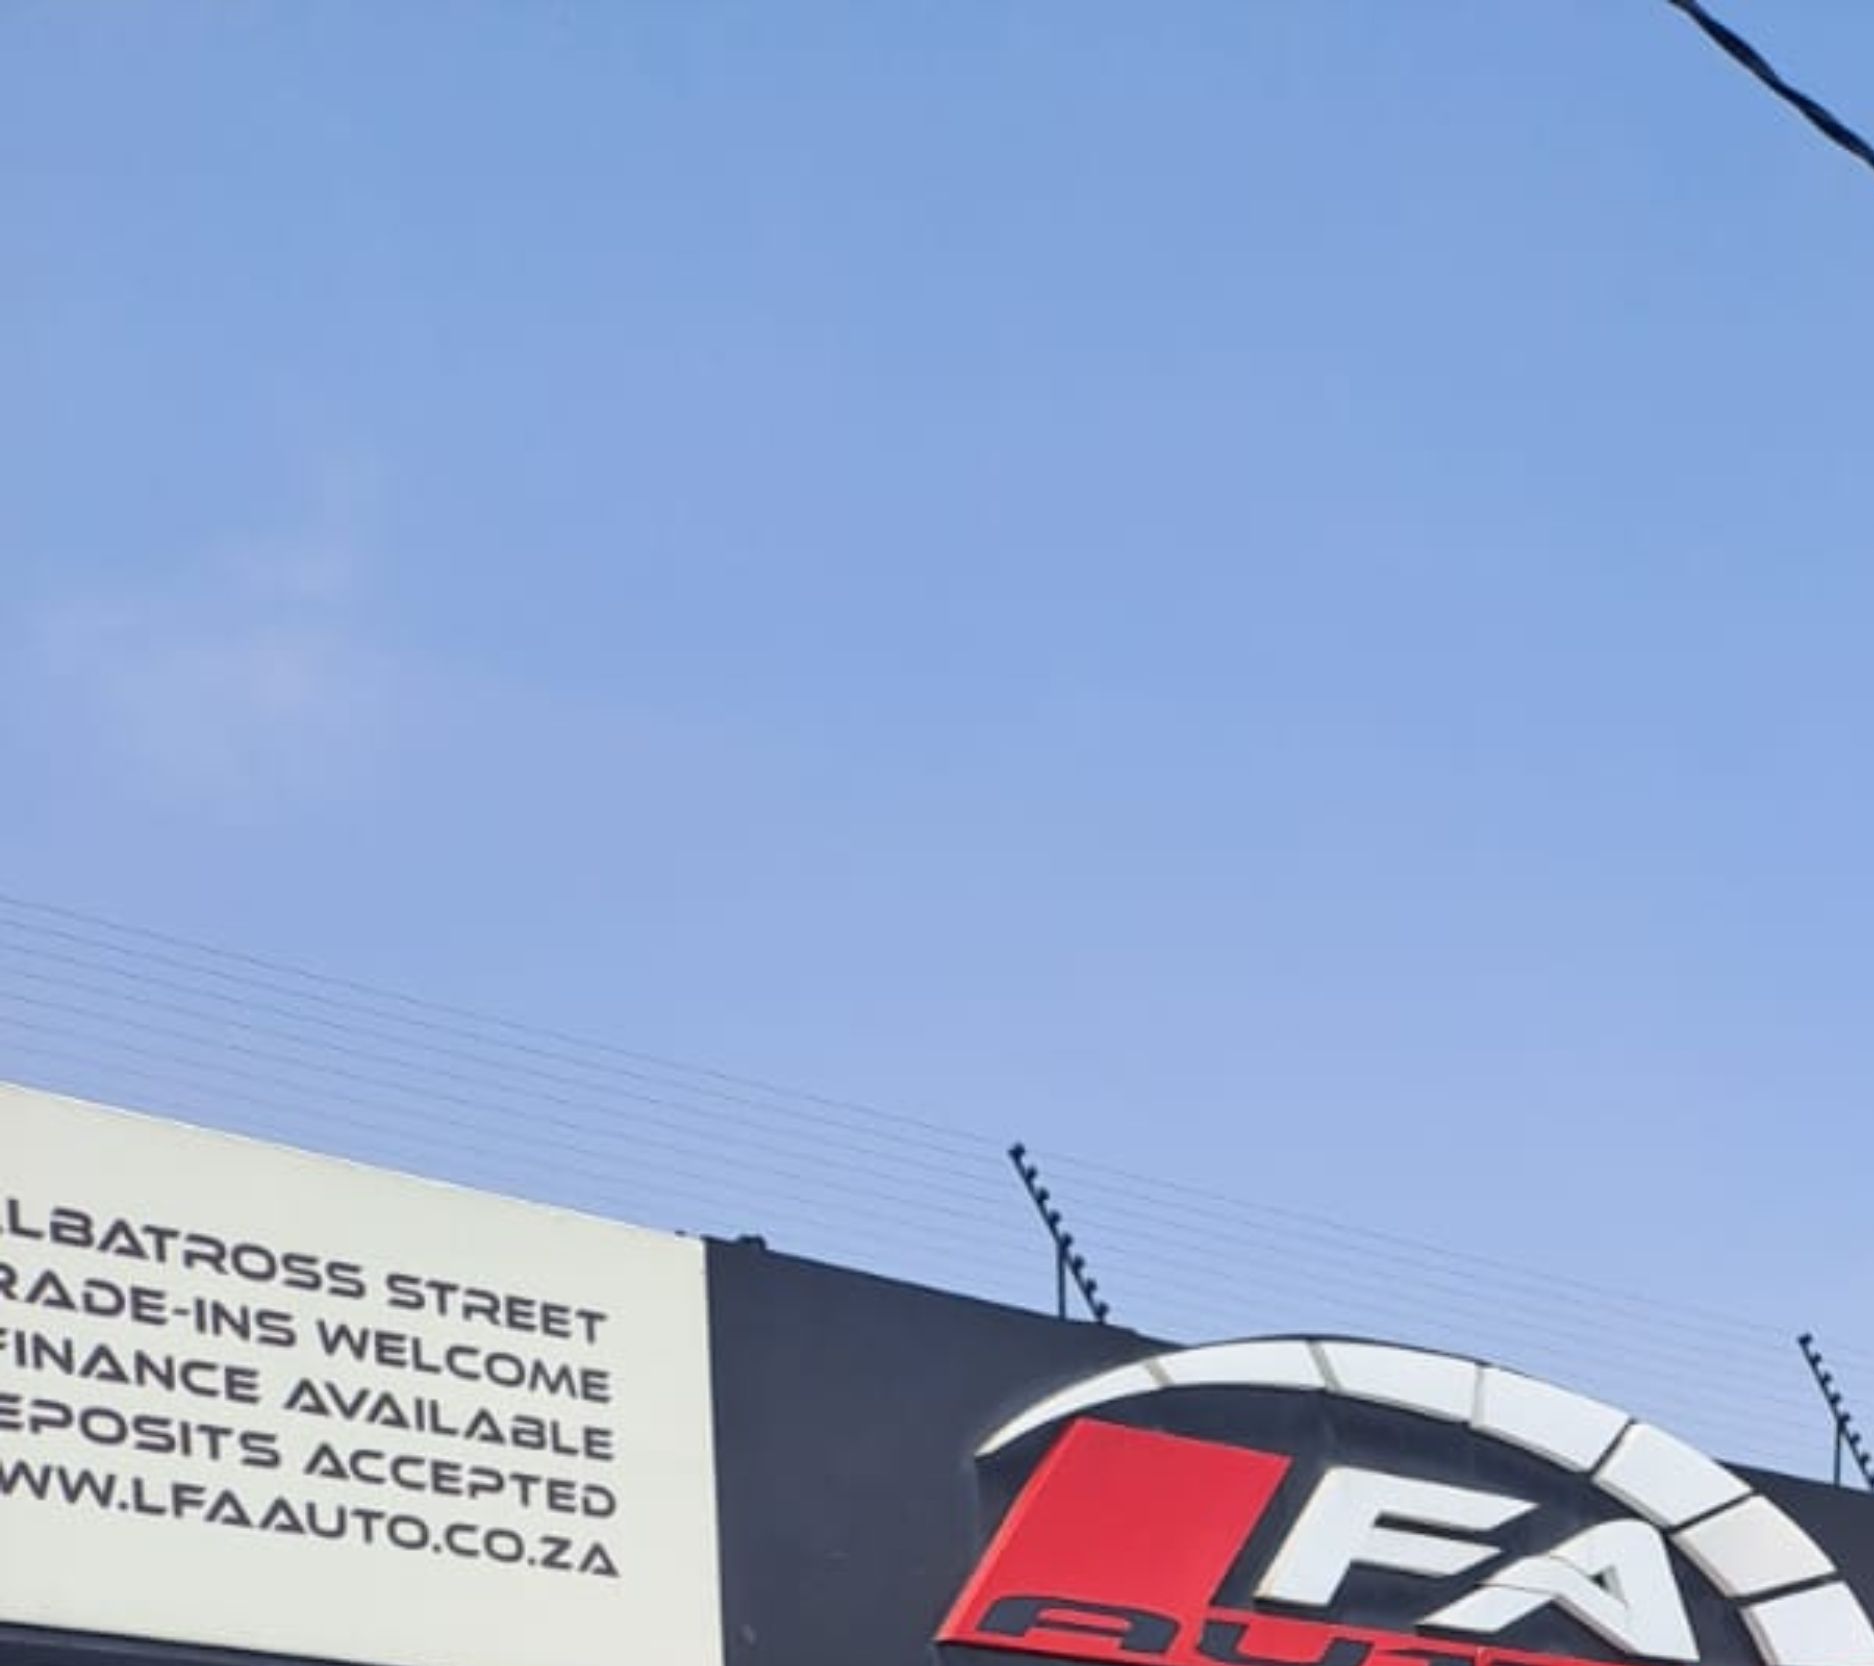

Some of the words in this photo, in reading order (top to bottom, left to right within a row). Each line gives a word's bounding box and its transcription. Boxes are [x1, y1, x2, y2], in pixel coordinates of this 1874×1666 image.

[0, 1198, 366, 1299] LBATROSS
[386, 1273, 607, 1343] STREET
[0, 1327, 260, 1404] INANCE
[284, 1378, 613, 1461] AVAILABLE
[316, 1320, 610, 1404] WELCOME
[0, 1458, 619, 1577] WW.LFAAUTO.CO.ZA
[304, 1443, 616, 1518] ACCEPTED
